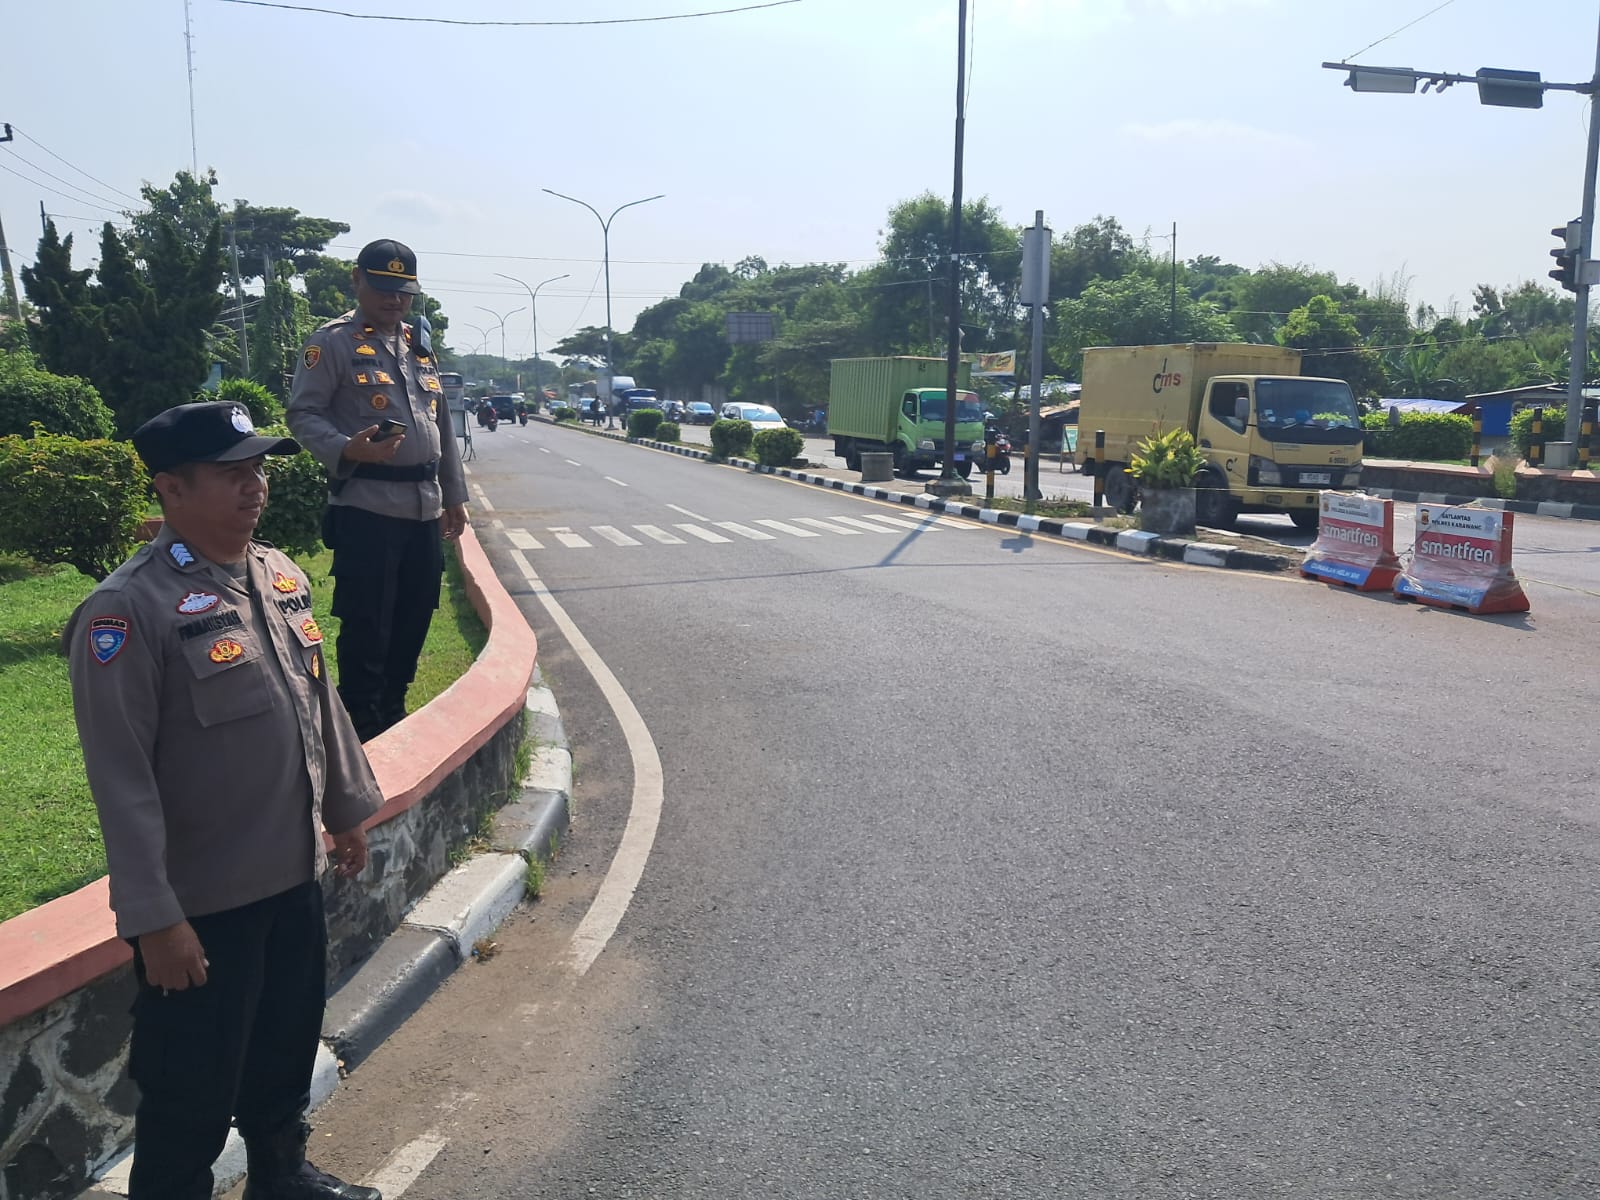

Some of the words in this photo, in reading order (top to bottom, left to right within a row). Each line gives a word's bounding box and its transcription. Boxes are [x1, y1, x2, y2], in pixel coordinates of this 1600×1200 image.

[1441, 512, 1471, 521] SATLANTAS
[1323, 524, 1379, 547] smartfren
[1421, 540, 1493, 563] smartfren
